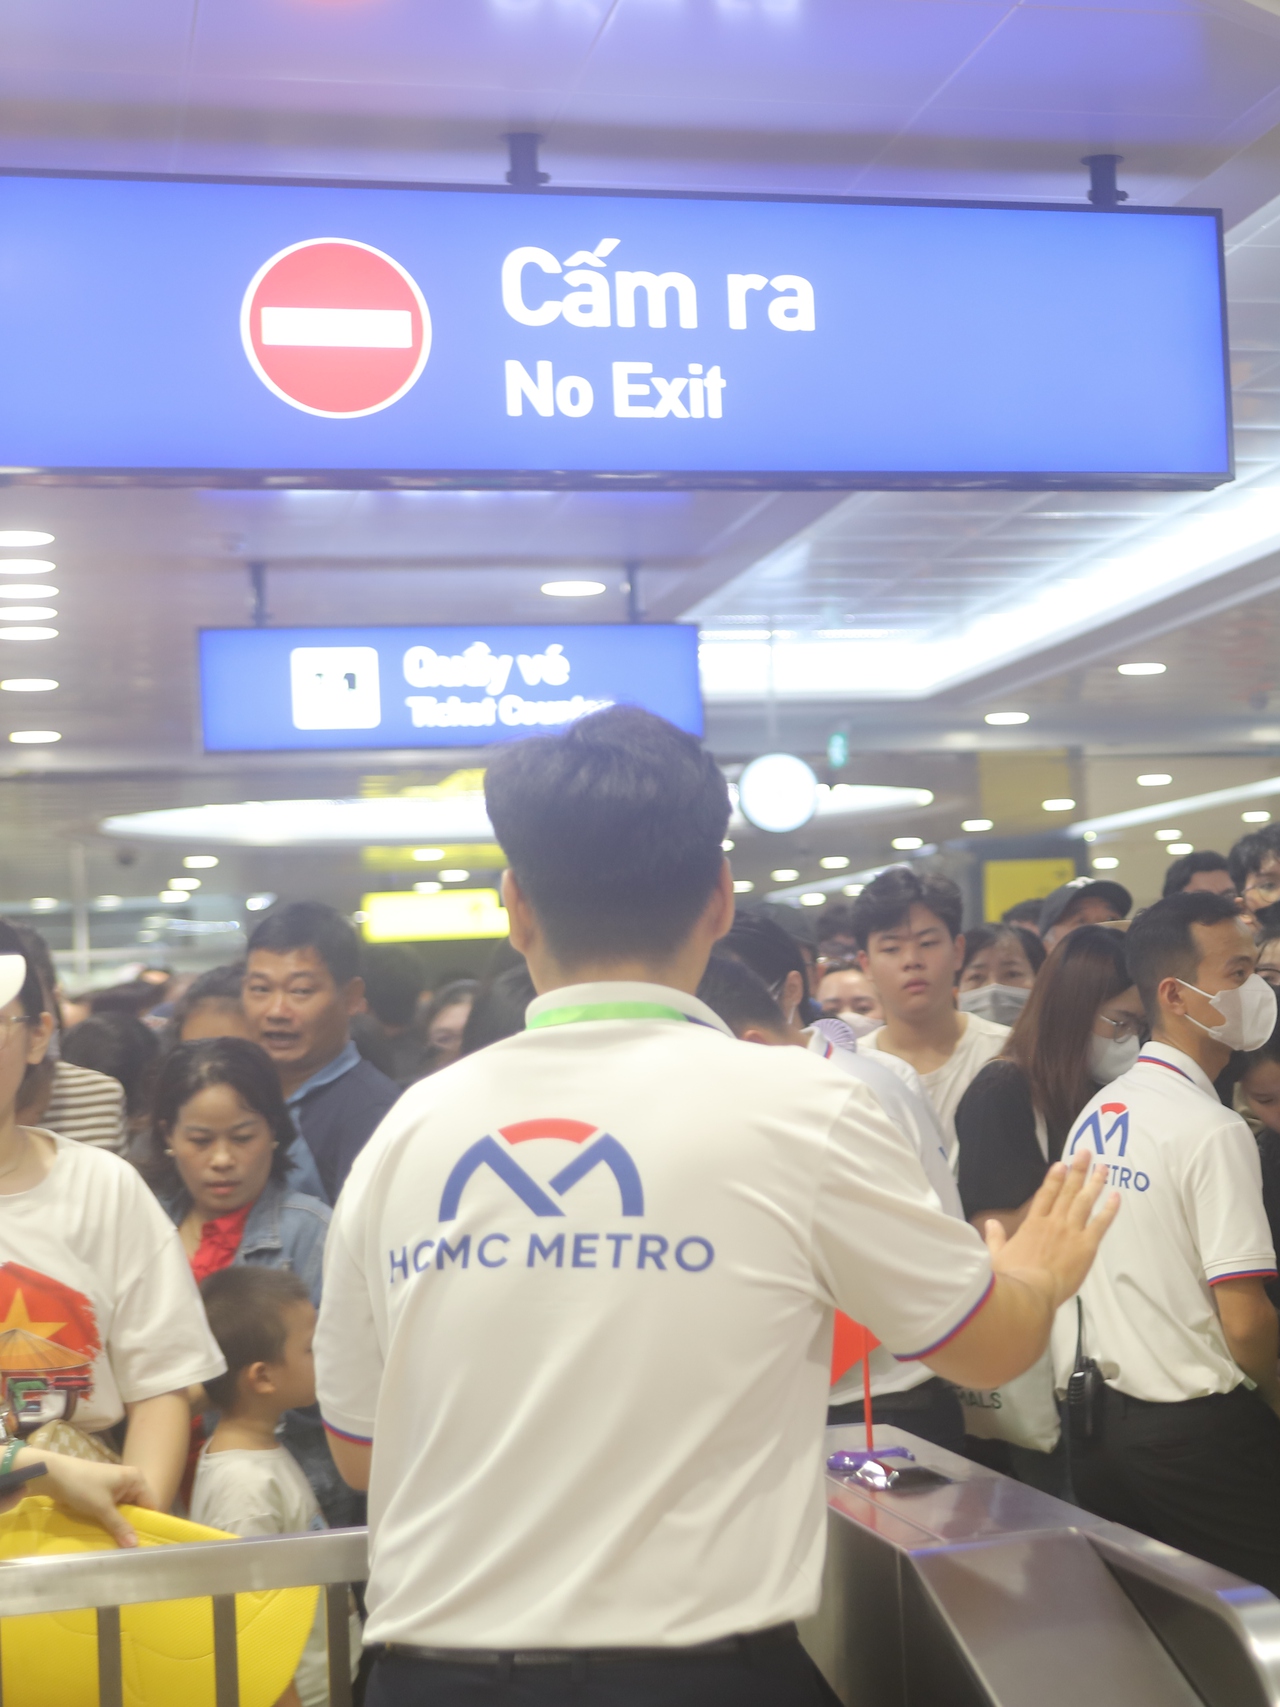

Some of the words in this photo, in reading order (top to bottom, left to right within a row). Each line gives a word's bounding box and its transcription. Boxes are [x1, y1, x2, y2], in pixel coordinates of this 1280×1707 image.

[501, 238, 698, 327] Cấm
[727, 273, 816, 331] ra
[505, 359, 594, 417] No
[612, 361, 727, 418] Exit
[1092, 1163, 1151, 1193] TRO
[389, 1232, 511, 1284] HCMC
[526, 1232, 715, 1273] METRO
